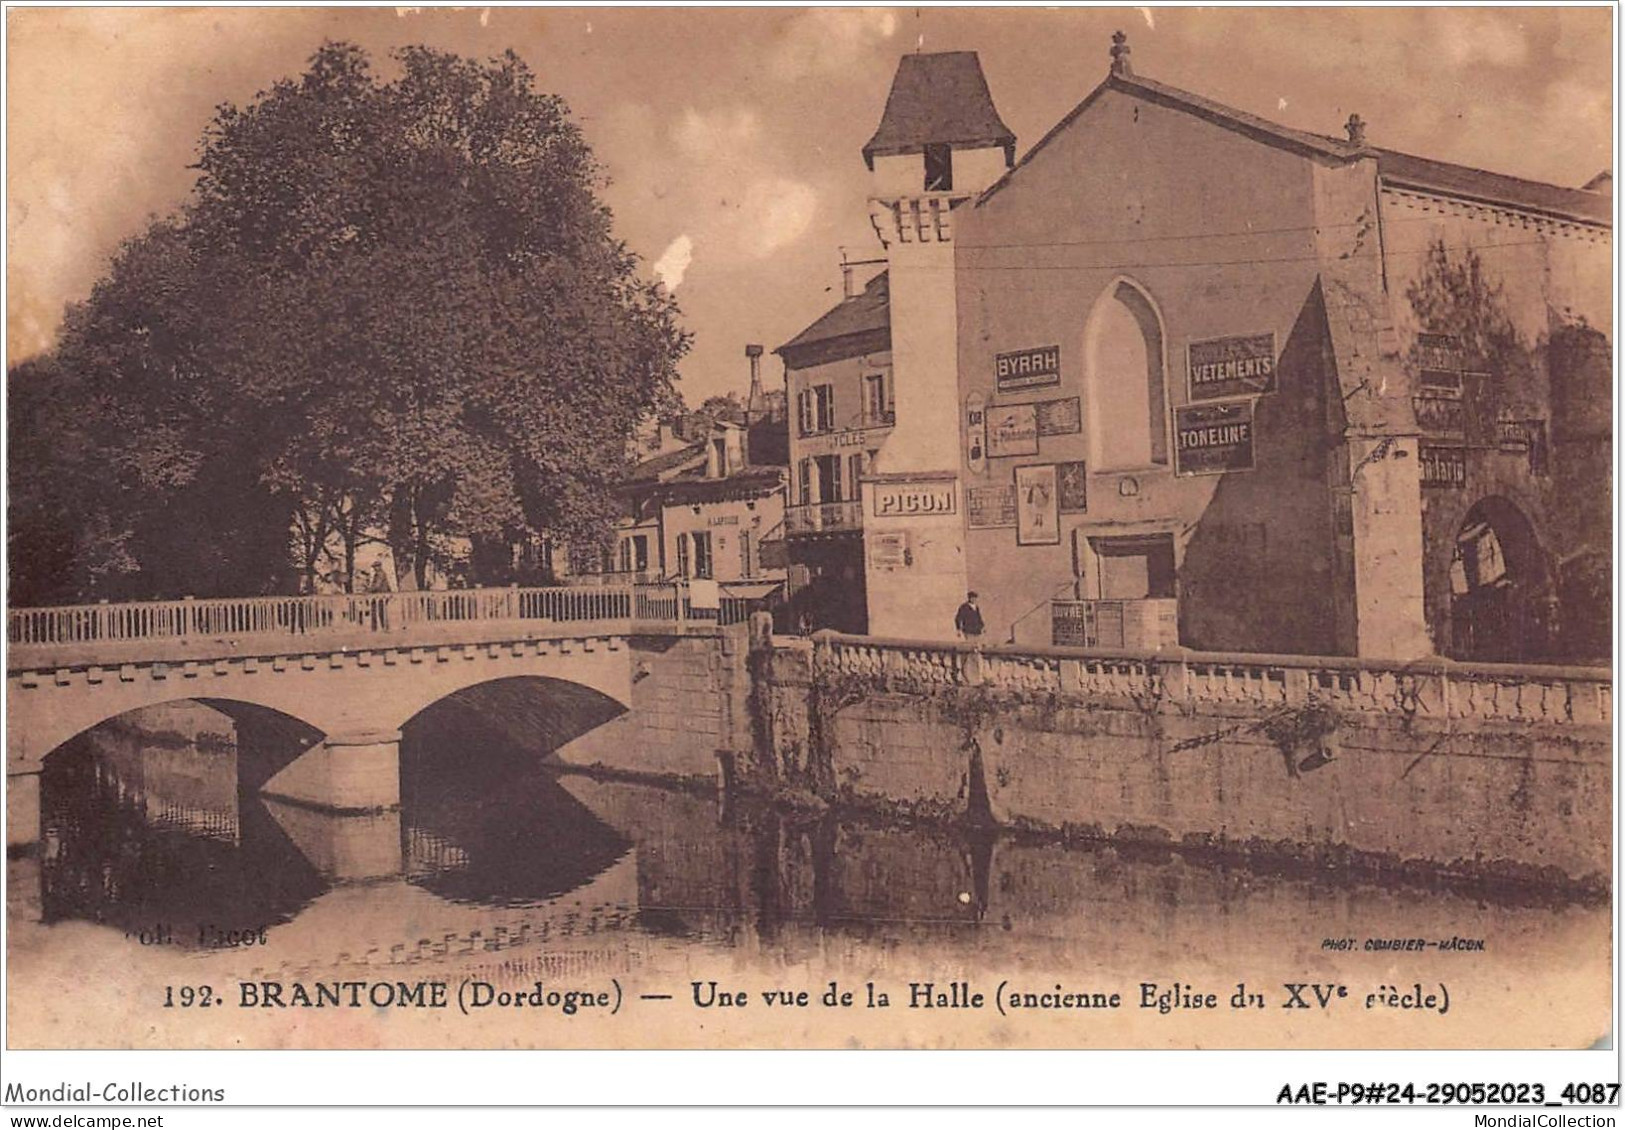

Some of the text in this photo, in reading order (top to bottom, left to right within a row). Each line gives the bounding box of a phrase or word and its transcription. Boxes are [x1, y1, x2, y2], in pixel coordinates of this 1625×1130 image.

[998, 352, 1057, 377] BYRRH
[1180, 424, 1249, 448] TONELINE
[882, 492, 951, 513] PICON
